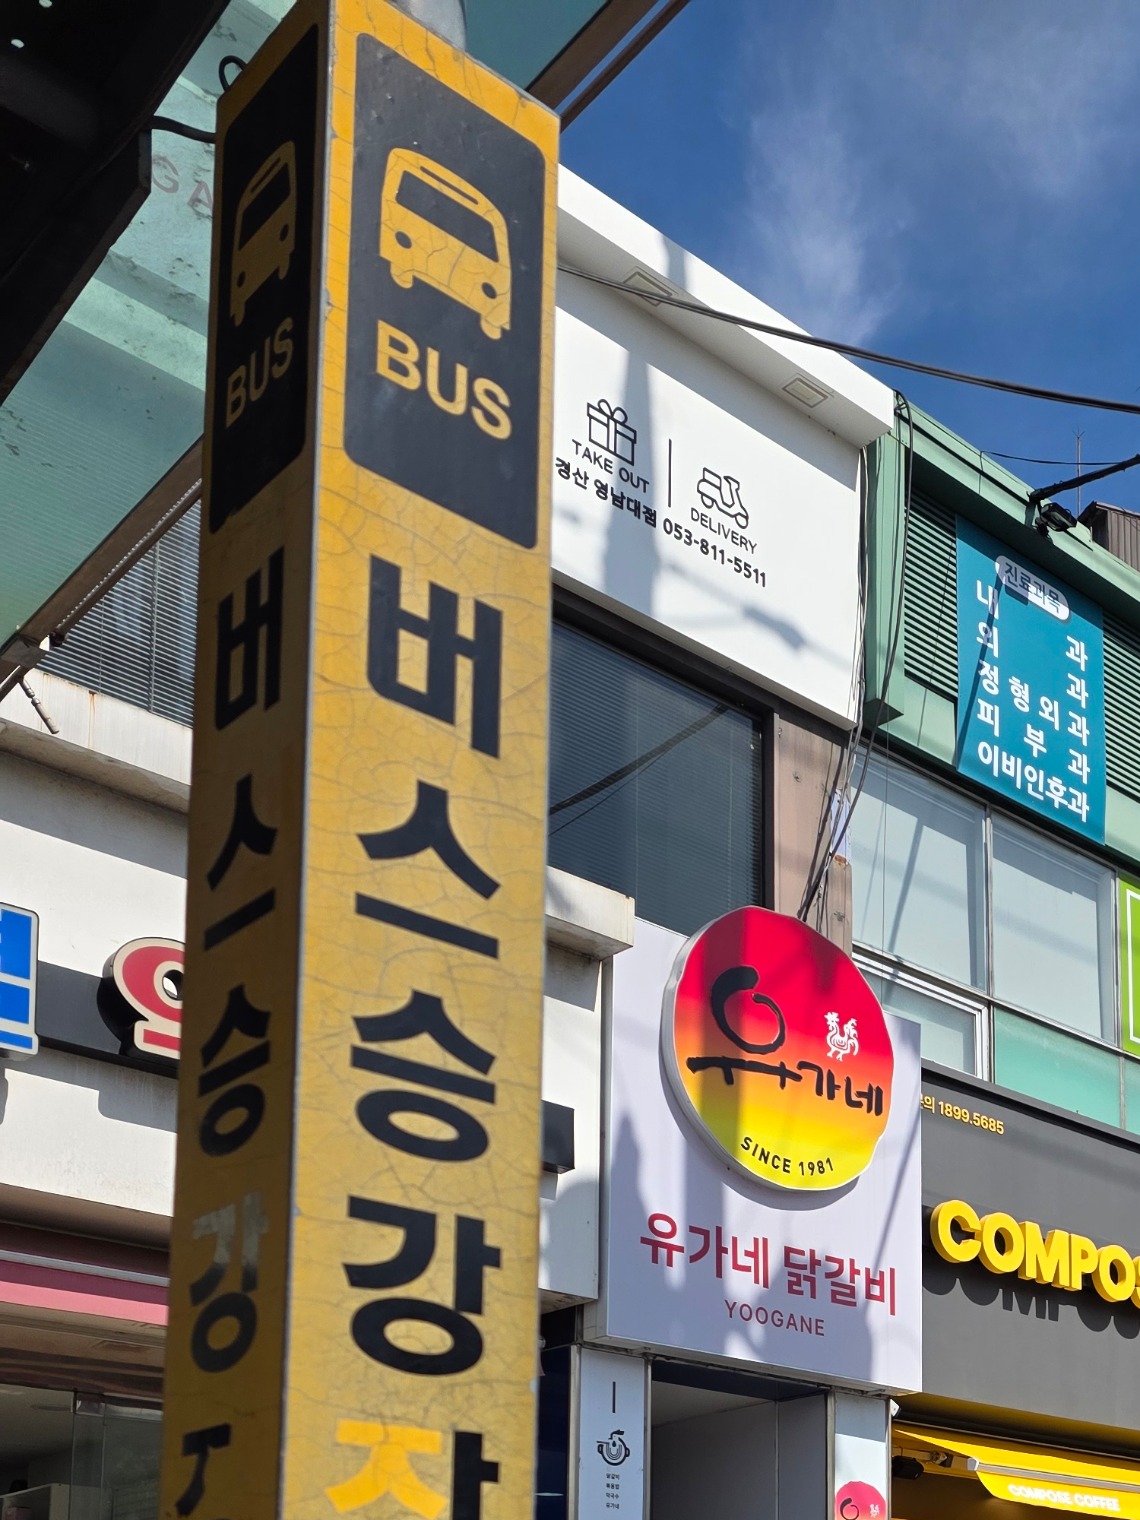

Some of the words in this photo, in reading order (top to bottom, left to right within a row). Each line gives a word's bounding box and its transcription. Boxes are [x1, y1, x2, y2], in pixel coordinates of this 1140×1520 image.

[225, 317, 294, 428] BUS
[376, 319, 513, 440] BUS
[572, 439, 613, 475] TAKE
[619, 466, 650, 494] OUT
[555, 457, 589, 490] 경산
[594, 477, 657, 528] 영남대점
[663, 518, 766, 588] 053-811-5511
[691, 507, 757, 555] DELIVERY
[1005, 561, 1061, 614] 진료과목
[977, 741, 1090, 822] 이비인후과
[686, 966, 882, 1117] 유가네
[938, 1101, 1005, 1135] 1899.5685
[740, 1136, 792, 1175] SINCE
[799, 1156, 834, 1176] 1981
[640, 1213, 769, 1290] 유가네
[784, 1246, 896, 1316] 닭갈비
[724, 1299, 825, 1337] YOOGANE
[1007, 1484, 1071, 1506] COMPOSE
[1074, 1493, 1120, 1512] COFFEE
